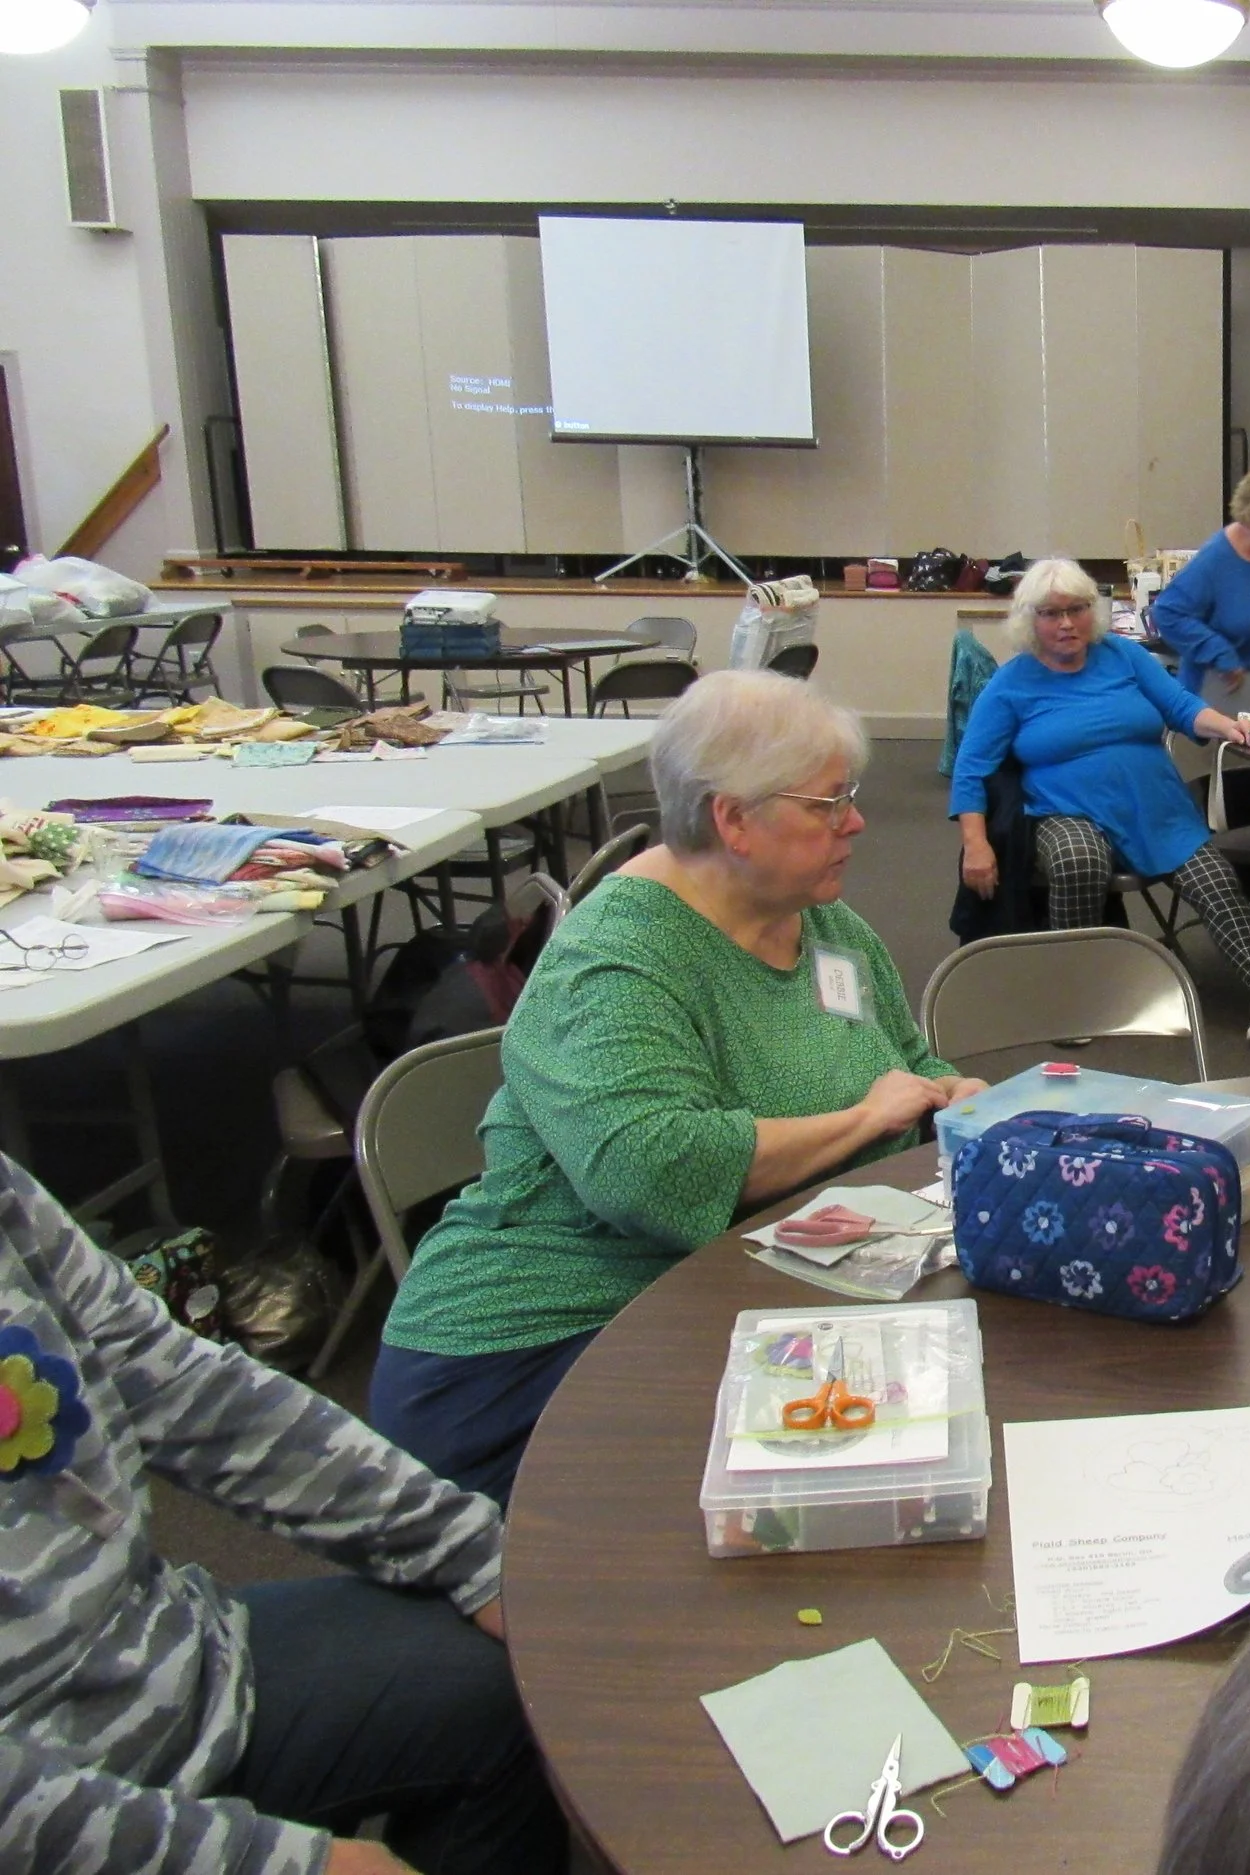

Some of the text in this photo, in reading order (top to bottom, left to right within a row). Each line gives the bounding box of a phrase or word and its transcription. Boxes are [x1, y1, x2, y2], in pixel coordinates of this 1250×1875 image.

[450, 375, 484, 385] Source:
[450, 384, 491, 395] No Signal
[451, 401, 463, 410] To
[464, 402, 494, 414] display
[520, 405, 544, 415] press
[563, 420, 590, 430] button
[1032, 1532, 1168, 1549] Plaid Sheep Company
